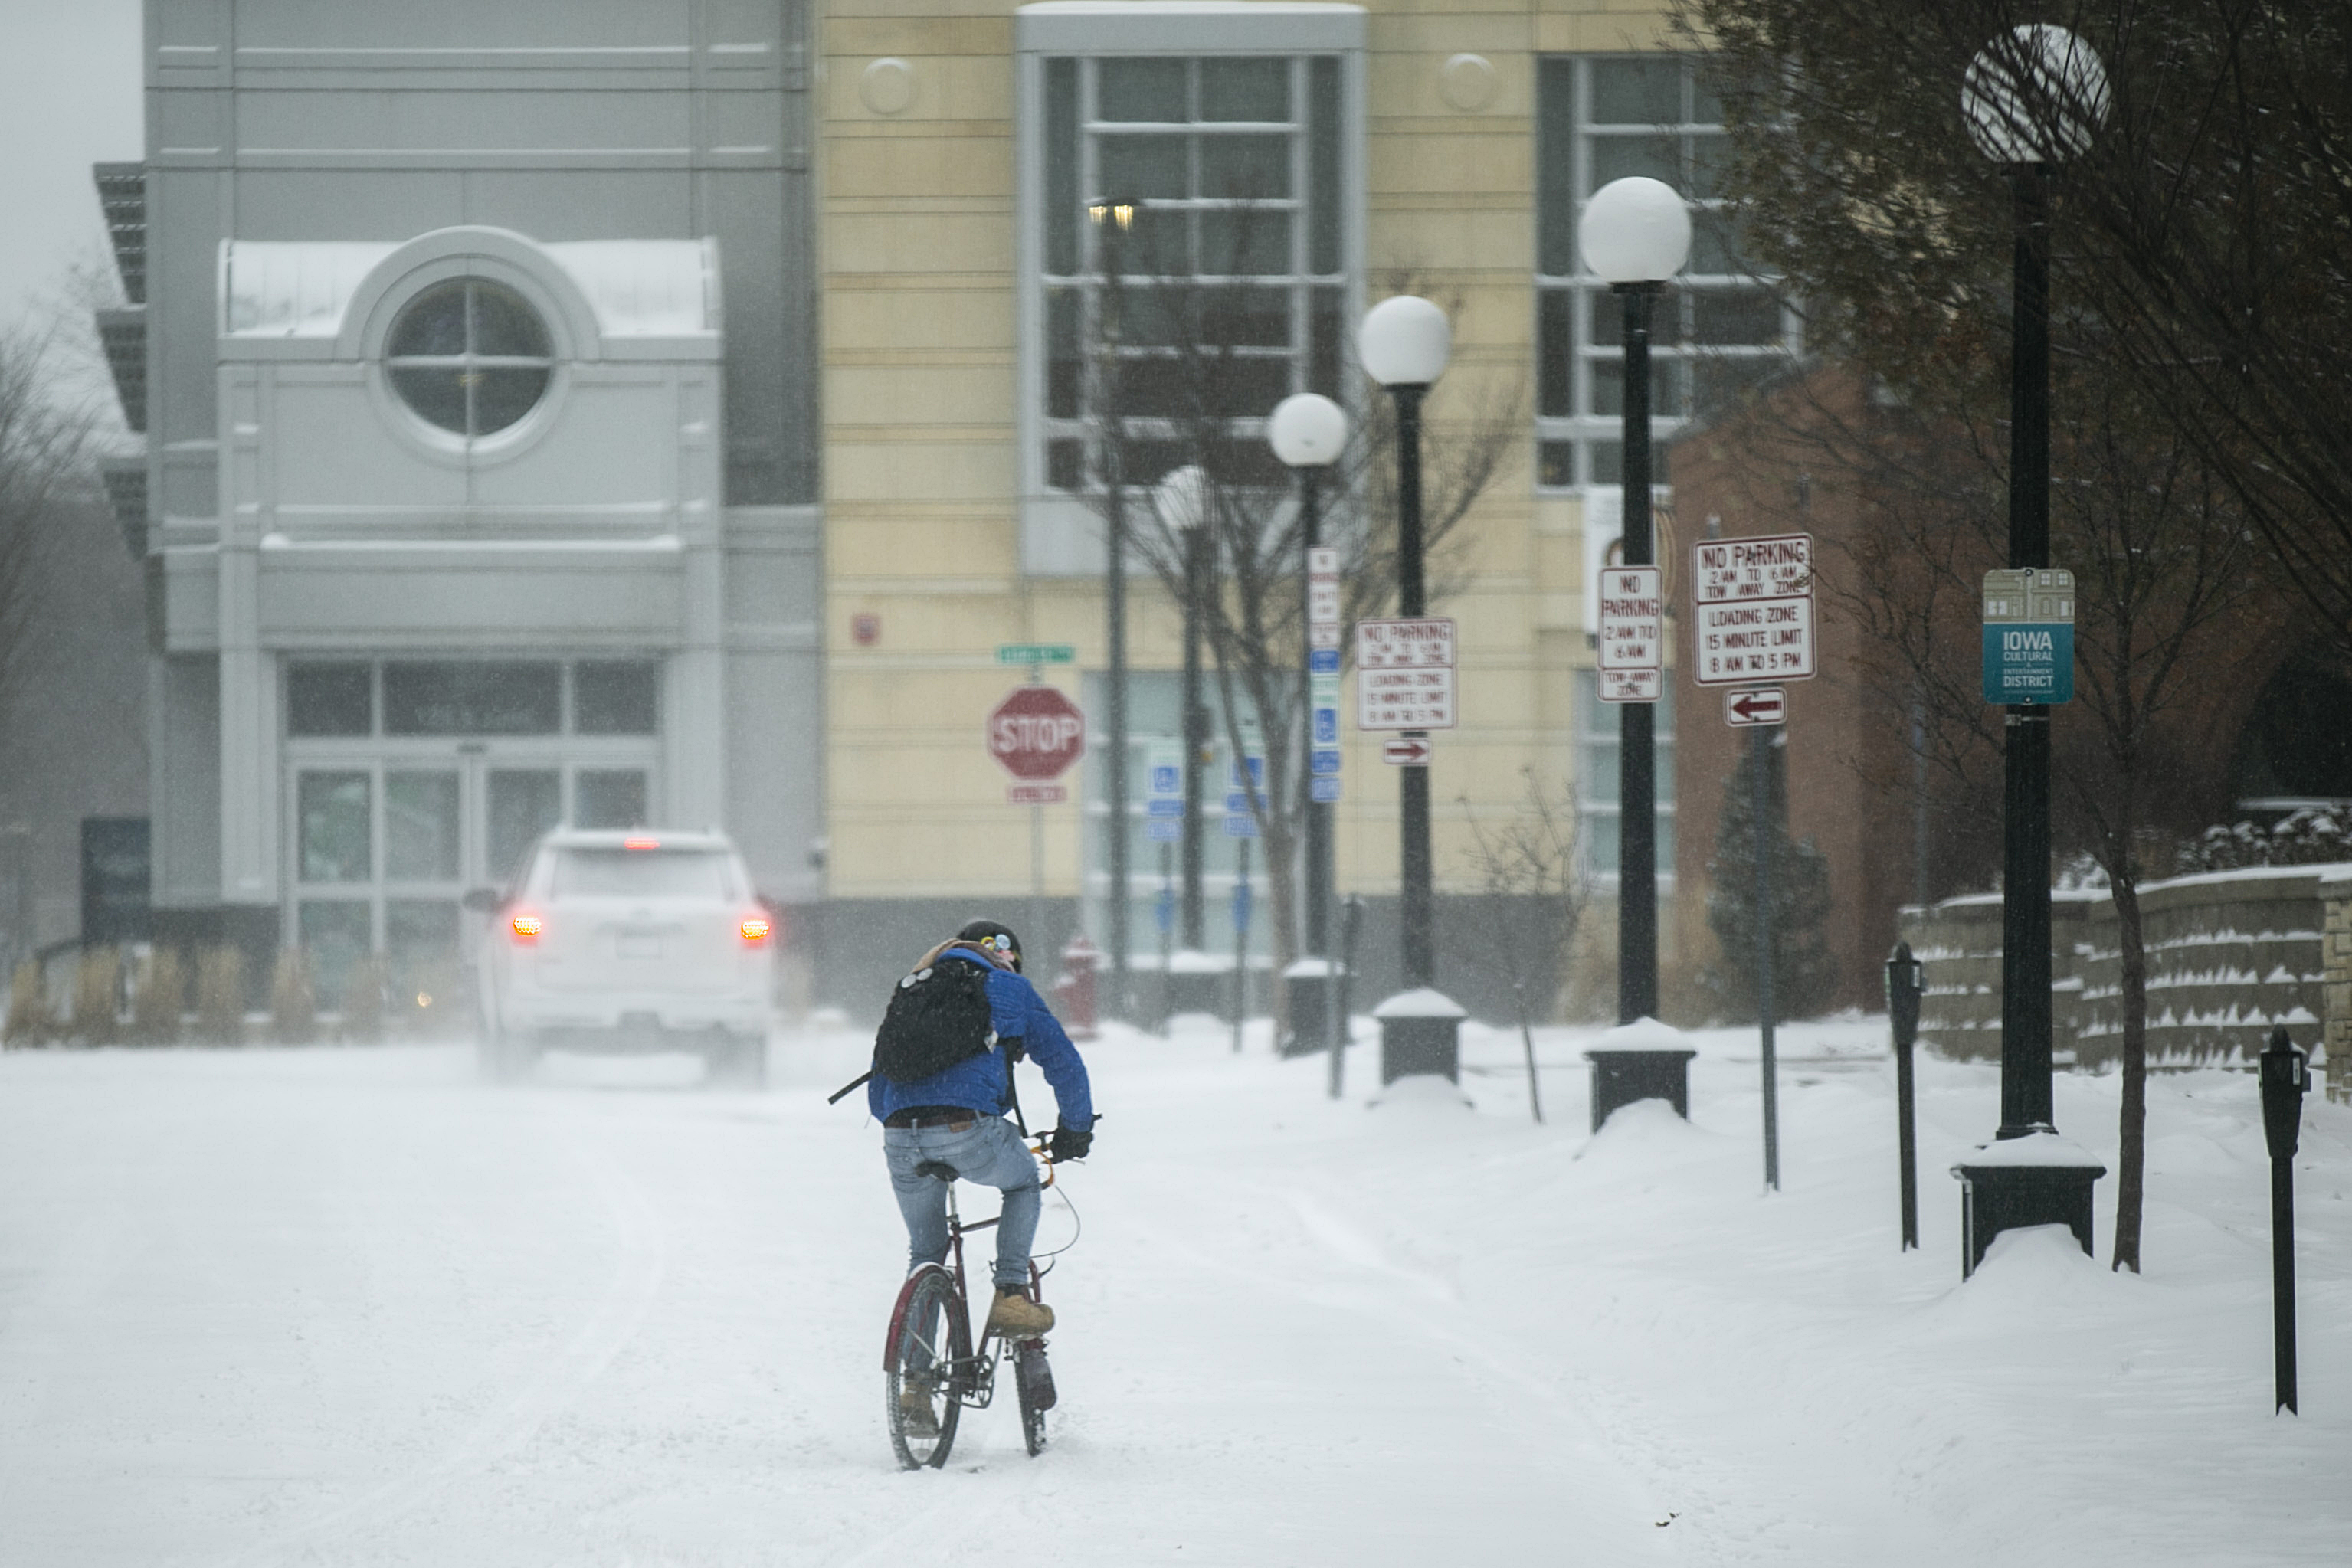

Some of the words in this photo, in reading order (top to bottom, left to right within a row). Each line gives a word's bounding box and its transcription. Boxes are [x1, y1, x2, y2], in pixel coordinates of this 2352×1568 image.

[1702, 547, 1727, 569] NO
[1732, 542, 1806, 568] PARKING
[1710, 571, 1718, 584] 2
[1721, 569, 1738, 583] AM
[1747, 568, 1761, 581] TO
[1770, 568, 1778, 581] 6
[1780, 566, 1797, 579] AM
[1620, 575, 1640, 594] NO
[1706, 585, 1727, 599] TOW
[1737, 583, 1765, 597] AWAY
[1775, 580, 1801, 594] ZON
[1602, 599, 1659, 617] PARKING
[1708, 608, 1762, 627] LOADING
[1766, 606, 1798, 624] ZONE
[1364, 627, 1382, 642] NO
[1390, 624, 1448, 641] PARKING
[1605, 626, 1614, 640] 2
[1617, 625, 1636, 639] AM
[1638, 624, 1657, 639] TO
[1706, 633, 1720, 650] 15
[1723, 630, 1768, 649] MINUTE
[1770, 629, 1802, 646] LIMIT
[2003, 631, 2053, 650] IOWA
[1627, 644, 1646, 658] AM
[2003, 651, 2053, 661] CULTURAL
[1710, 656, 1720, 673] 8
[1725, 656, 1743, 672] AM
[1747, 654, 1764, 670] TO
[1767, 653, 1778, 669] 5
[1781, 652, 1801, 668] PM
[1369, 674, 1412, 687] LOADING
[1417, 673, 1442, 686] ZONE
[2003, 676, 2053, 687] DISTRICT
[1367, 692, 1377, 705] 15
[1381, 692, 1416, 704] MINUTE
[1421, 691, 1445, 704] LIMIT
[1617, 685, 1642, 696] ZONE
[998, 717, 1081, 753] STOP
